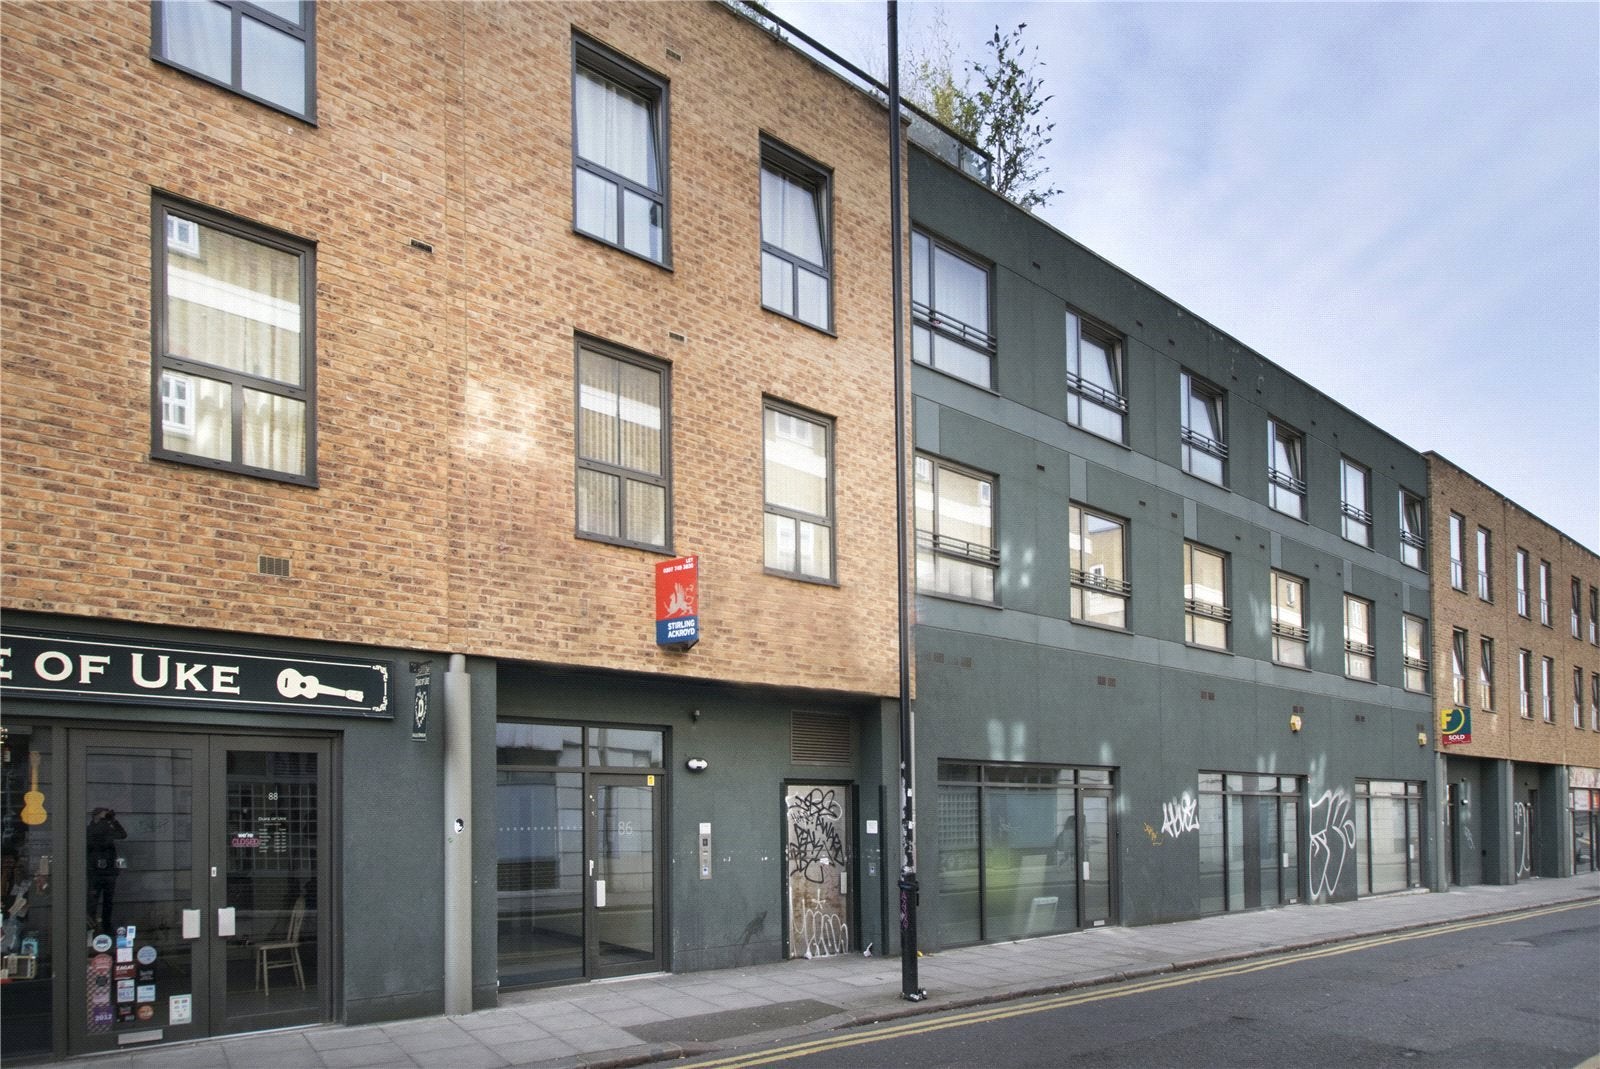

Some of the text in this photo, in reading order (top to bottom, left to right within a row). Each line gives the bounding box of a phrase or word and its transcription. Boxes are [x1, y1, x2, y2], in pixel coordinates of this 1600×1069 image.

[667, 619, 695, 630] STIRLING
[668, 628, 695, 638] ACKROYD
[34, 650, 111, 684] OF
[131, 652, 241, 695] UKE
[268, 792, 278, 800] 88
[617, 821, 633, 835] 86
[231, 838, 260, 847] CLOSED
[95, 1014, 113, 1022] 2012
